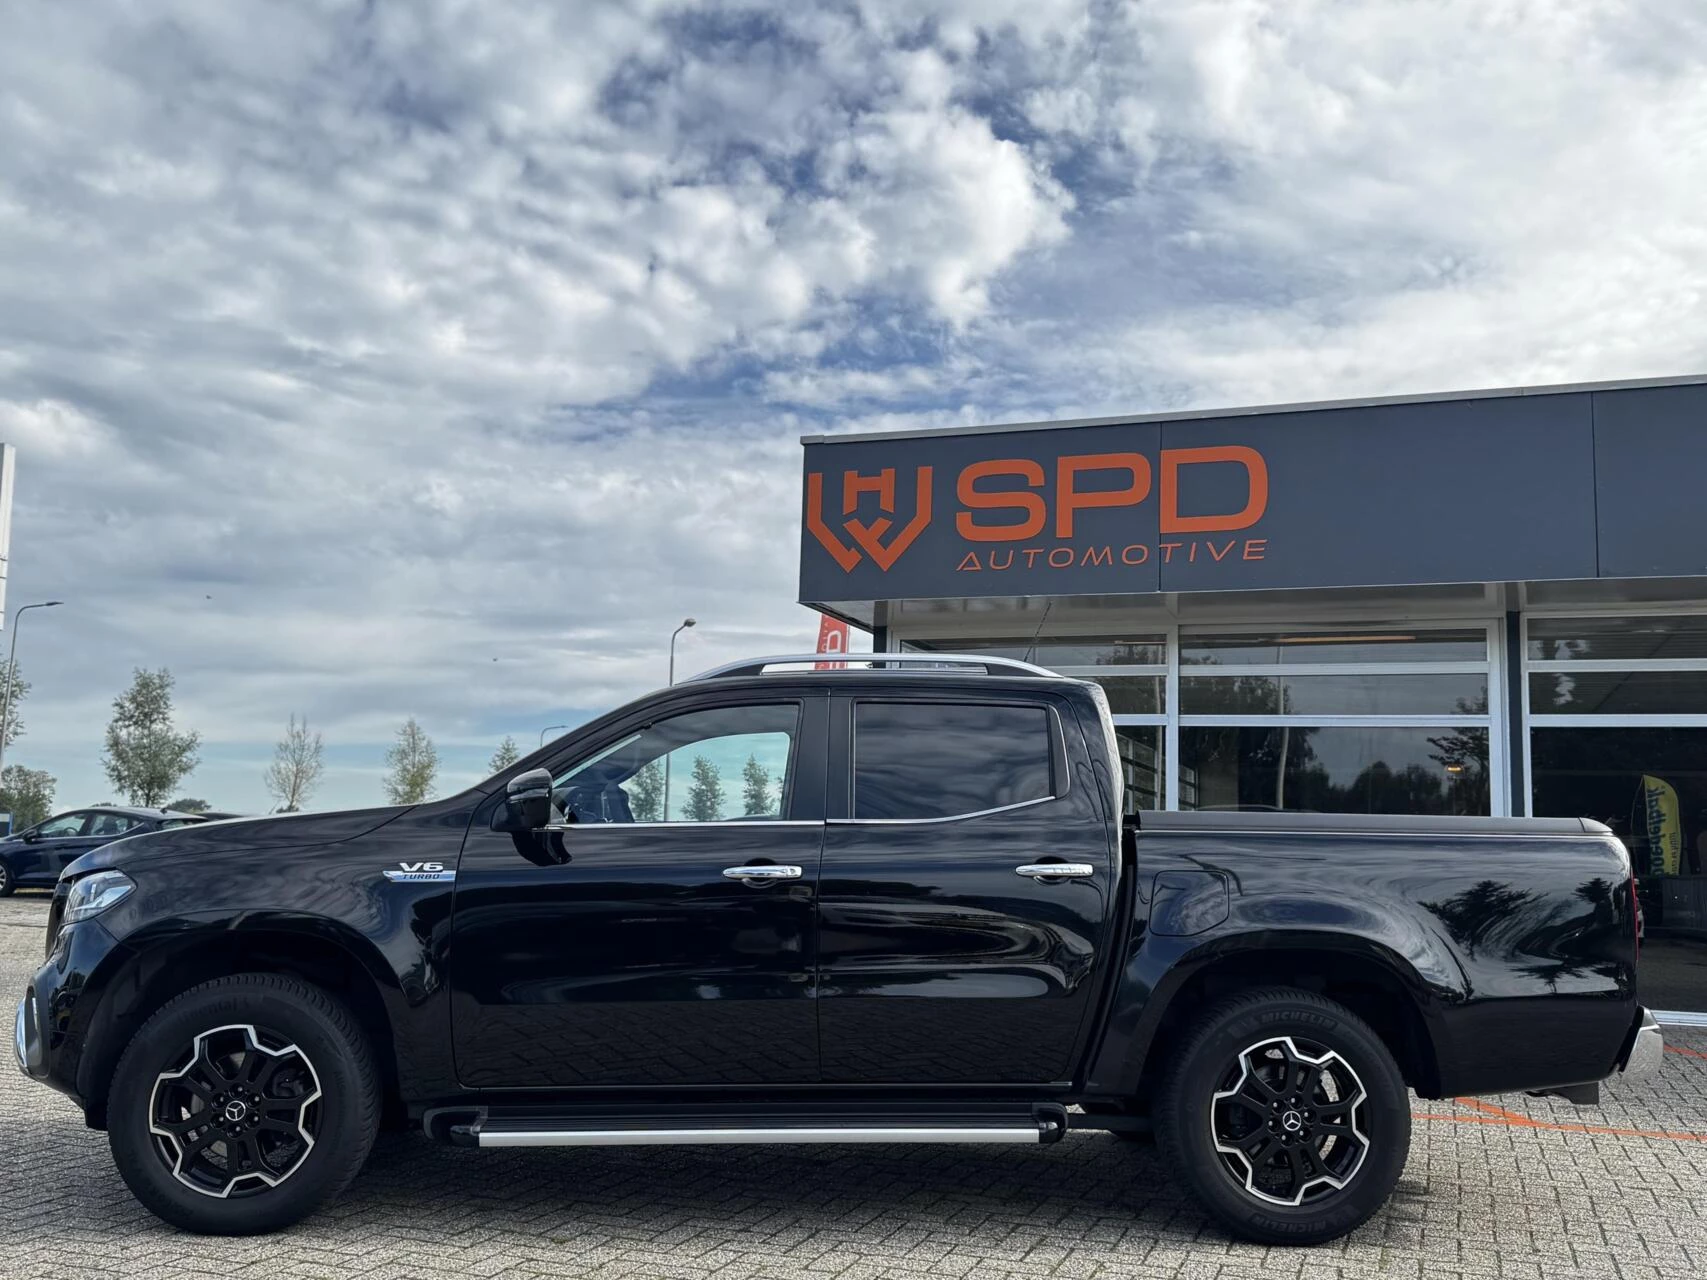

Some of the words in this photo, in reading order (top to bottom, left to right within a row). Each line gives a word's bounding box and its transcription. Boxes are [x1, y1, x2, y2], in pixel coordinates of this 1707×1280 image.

[956, 445, 1269, 541] SPD
[956, 539, 1268, 571] AUTOMOTIVE
[399, 862, 444, 872] V6
[1261, 1011, 1337, 1029] MICHELIN
[1250, 1215, 1327, 1232] MICHELIN
